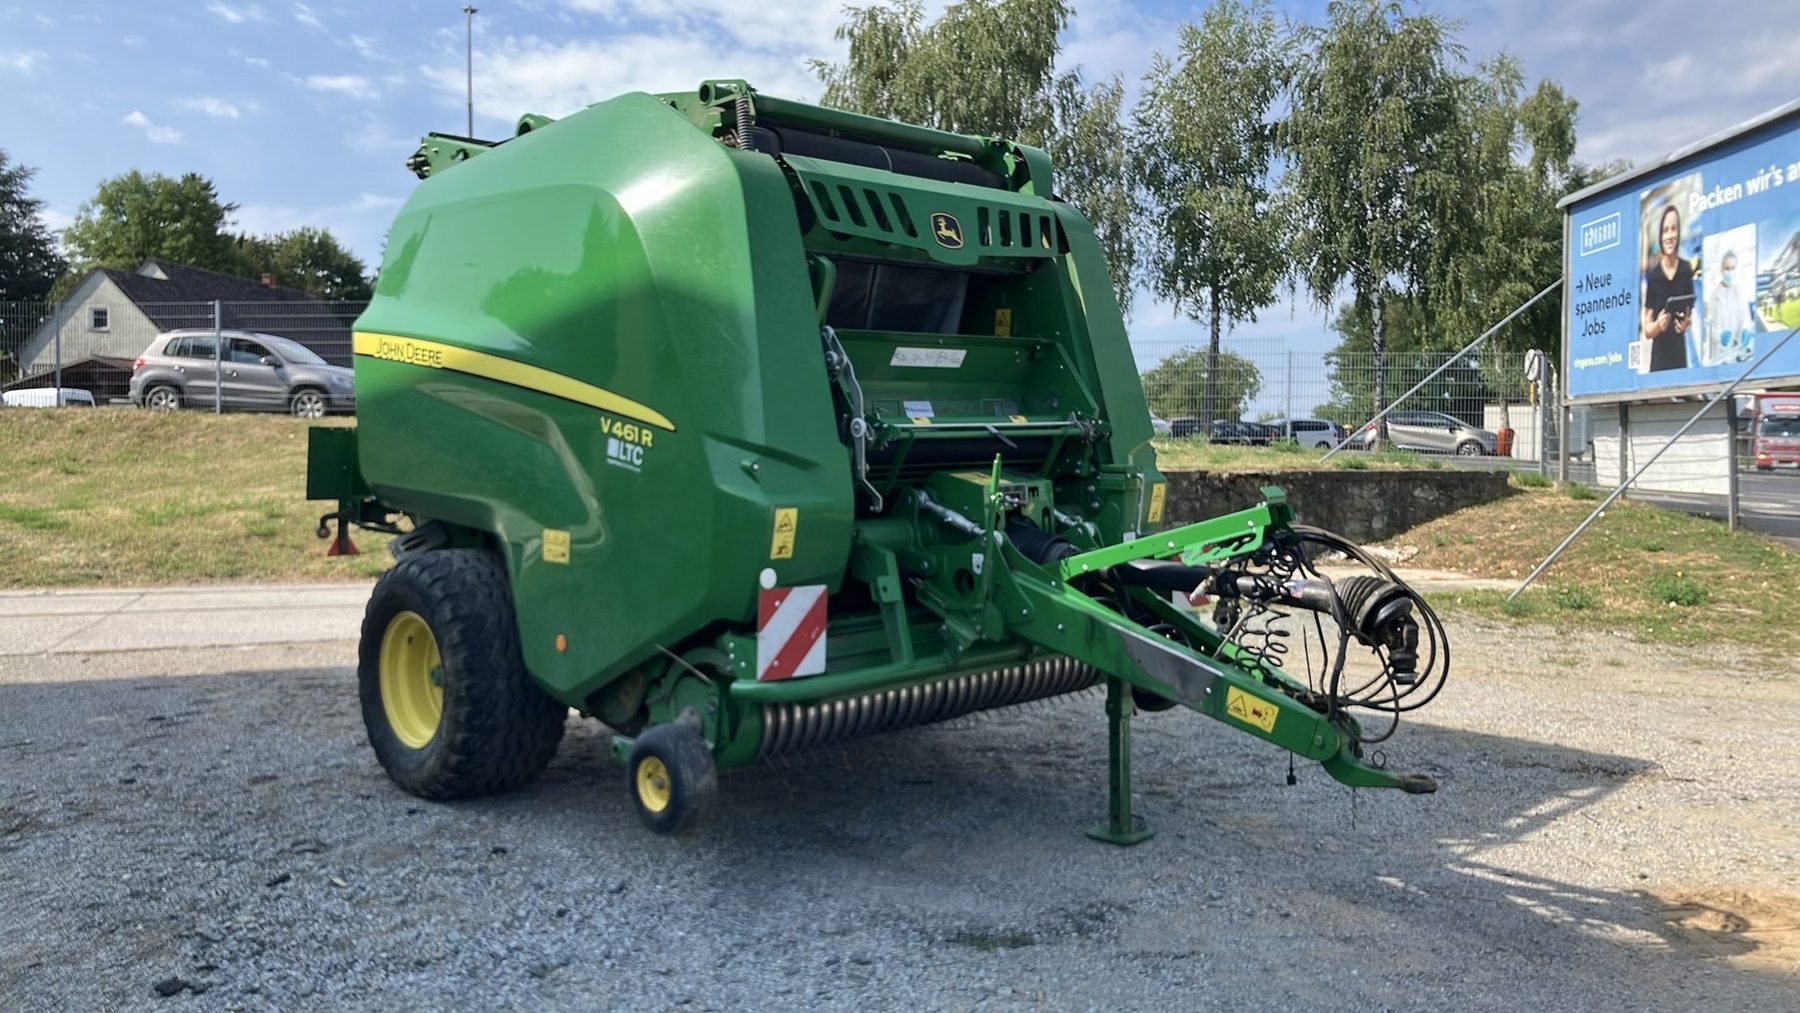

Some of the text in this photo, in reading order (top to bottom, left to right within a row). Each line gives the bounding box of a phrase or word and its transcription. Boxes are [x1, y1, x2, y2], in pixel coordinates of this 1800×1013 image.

[1689, 160, 1800, 214] Packen wir's a
[1585, 272, 1612, 292] Neue
[1575, 288, 1632, 320] spannende
[1582, 317, 1606, 337] Jobs
[600, 415, 653, 448] V 461 R
[619, 440, 644, 466] LTC
